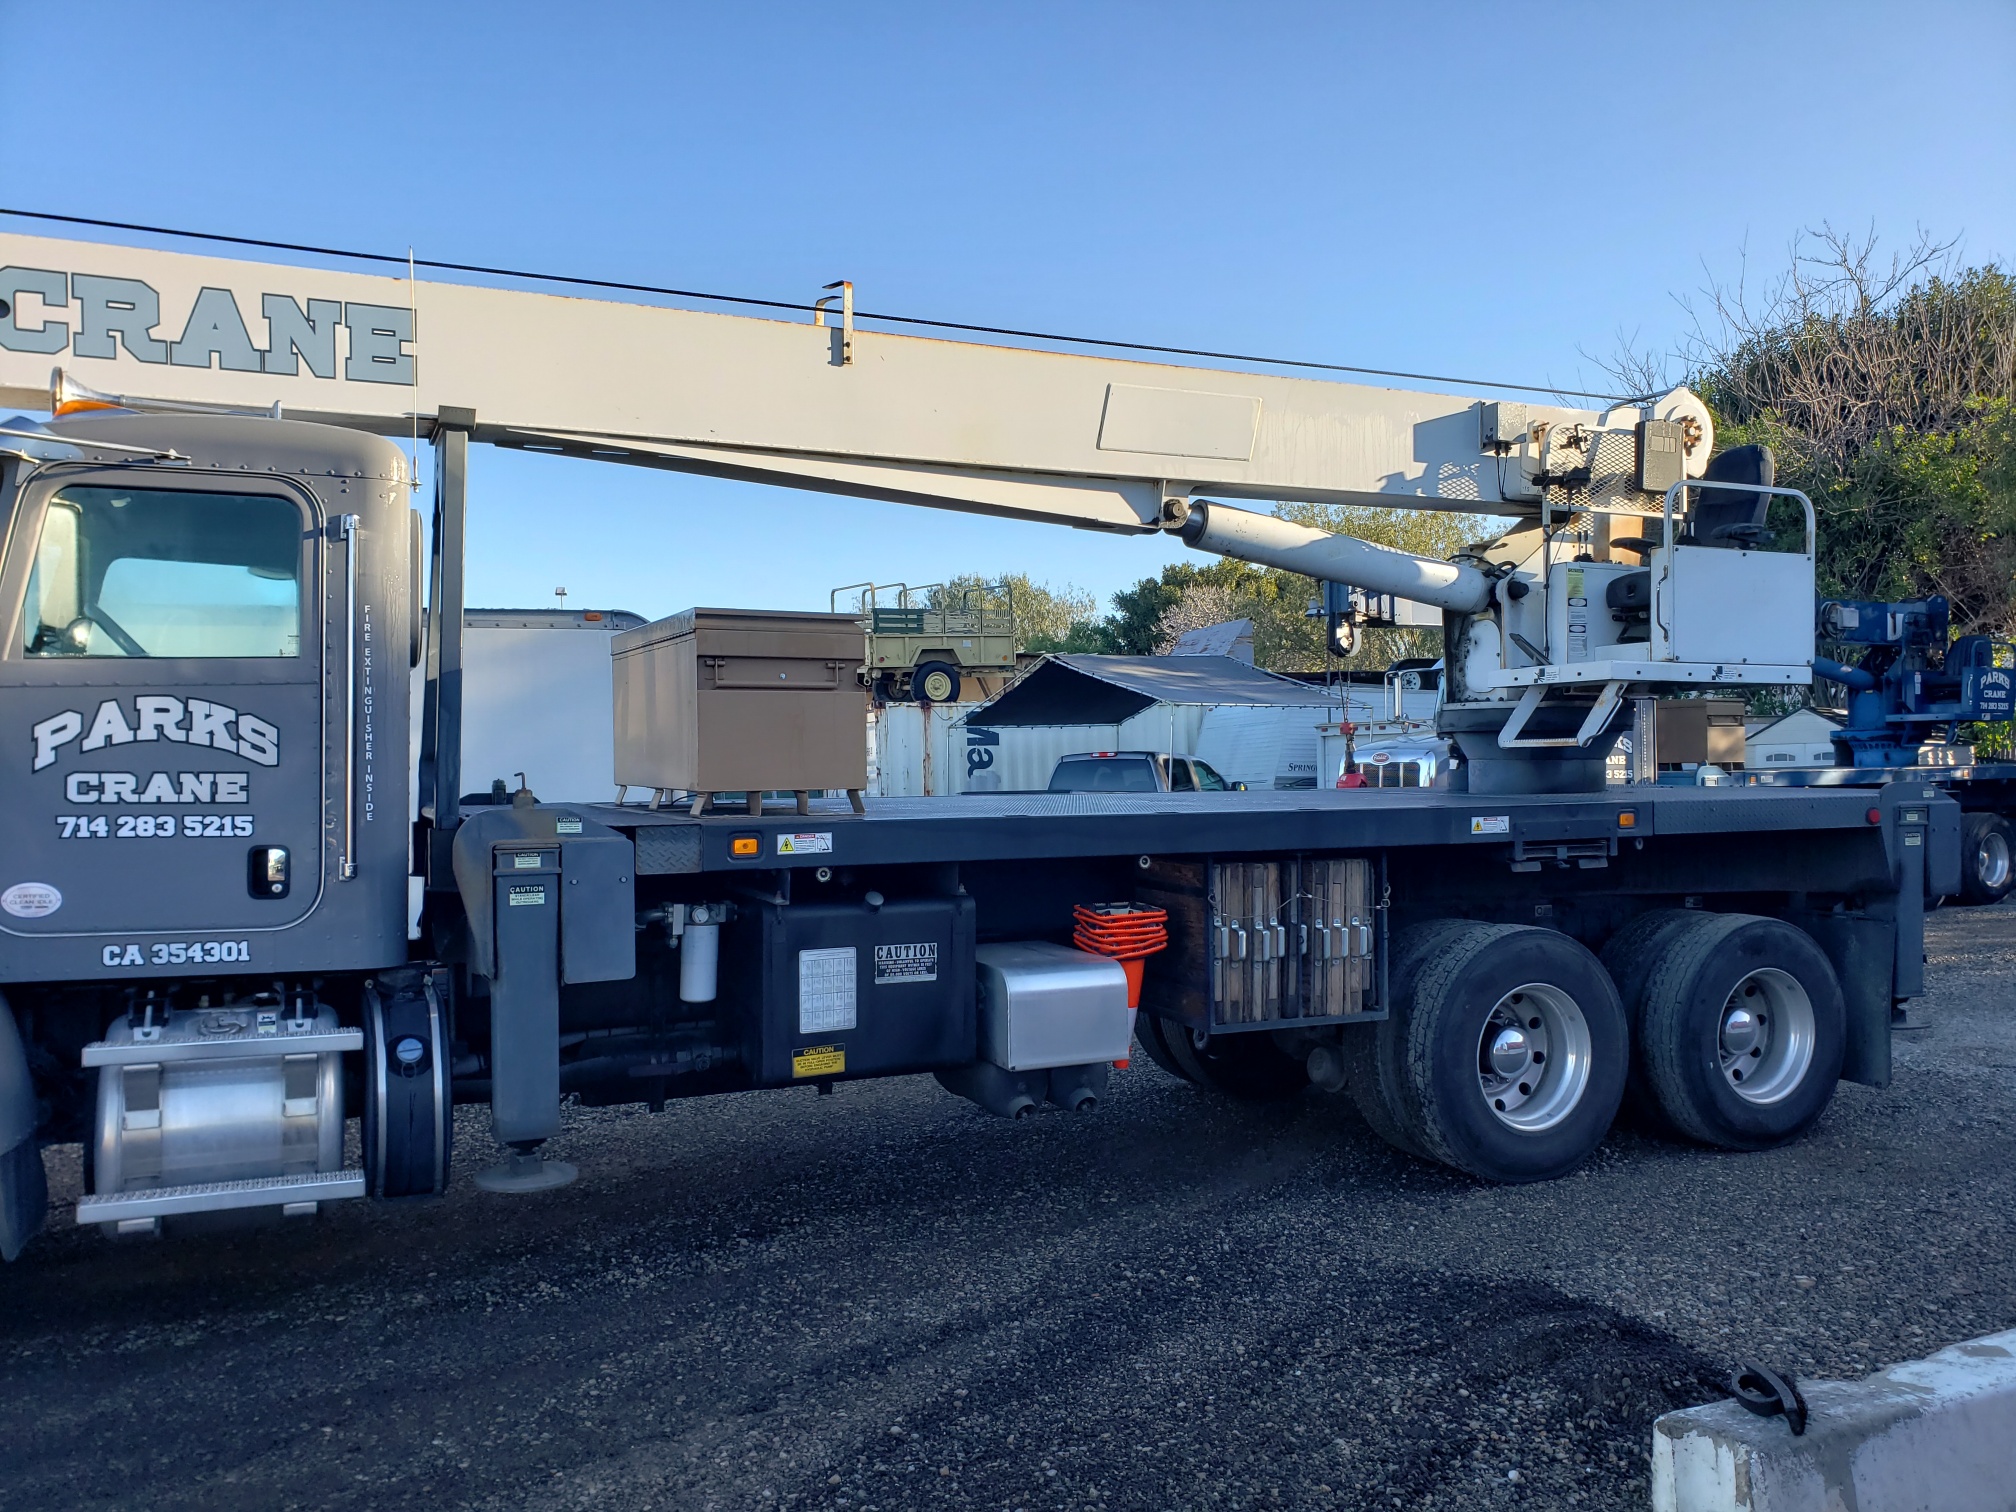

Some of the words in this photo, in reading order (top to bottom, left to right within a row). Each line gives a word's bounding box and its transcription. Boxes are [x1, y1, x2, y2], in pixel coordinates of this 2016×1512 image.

[0, 265, 418, 387] CRANE
[1980, 671, 2010, 690] PARKS
[364, 648, 373, 760] EXTINGUISHER
[1983, 690, 2006, 698] CRANE
[32, 694, 280, 774] PARKS
[1288, 762, 1318, 772] SPRING
[65, 770, 250, 804] CRANE
[365, 765, 374, 821] INSIDE
[56, 815, 110, 839] 714
[115, 815, 176, 838] 283
[183, 814, 254, 838] 5215
[509, 885, 544, 894] CAUTION
[102, 944, 145, 967] CA
[150, 941, 251, 966] 354301
[876, 944, 936, 960] CAUTION
[803, 1046, 834, 1056] CAUTION
